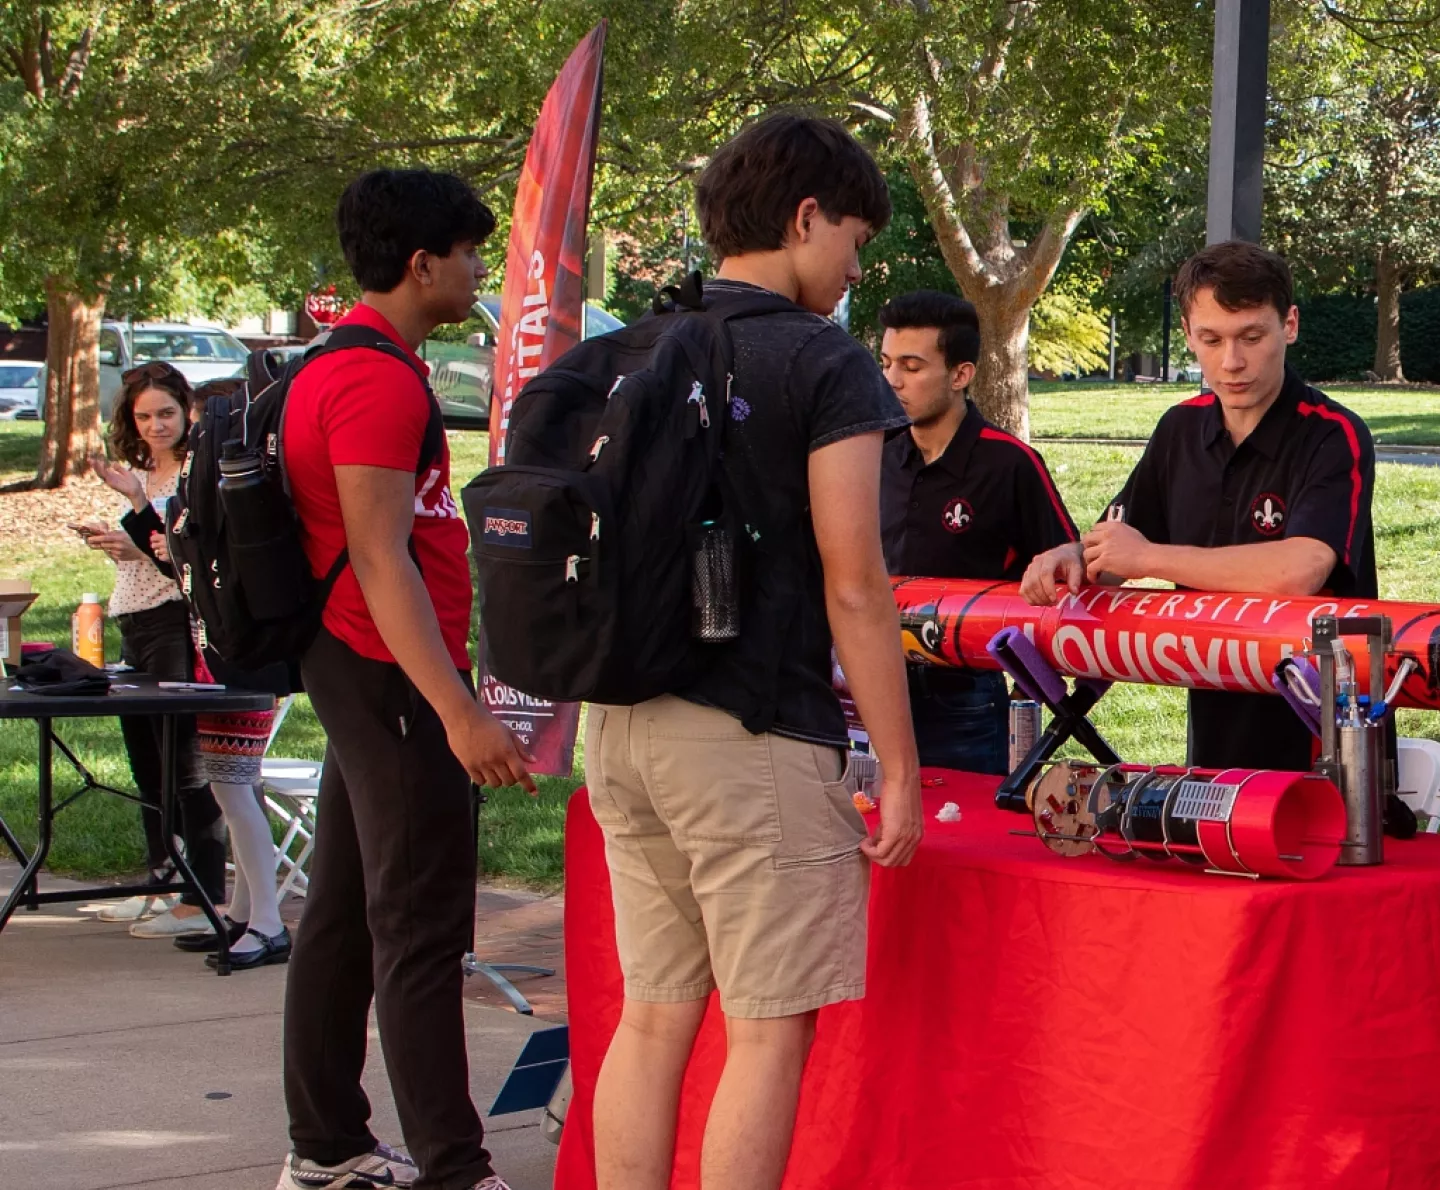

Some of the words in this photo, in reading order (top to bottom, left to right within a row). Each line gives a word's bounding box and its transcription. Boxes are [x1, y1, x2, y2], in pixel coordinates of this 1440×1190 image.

[1055, 588, 1291, 625] NIVERSITY
[1022, 621, 1294, 694] OUISVIL
[506, 720, 534, 732] CHOOL
